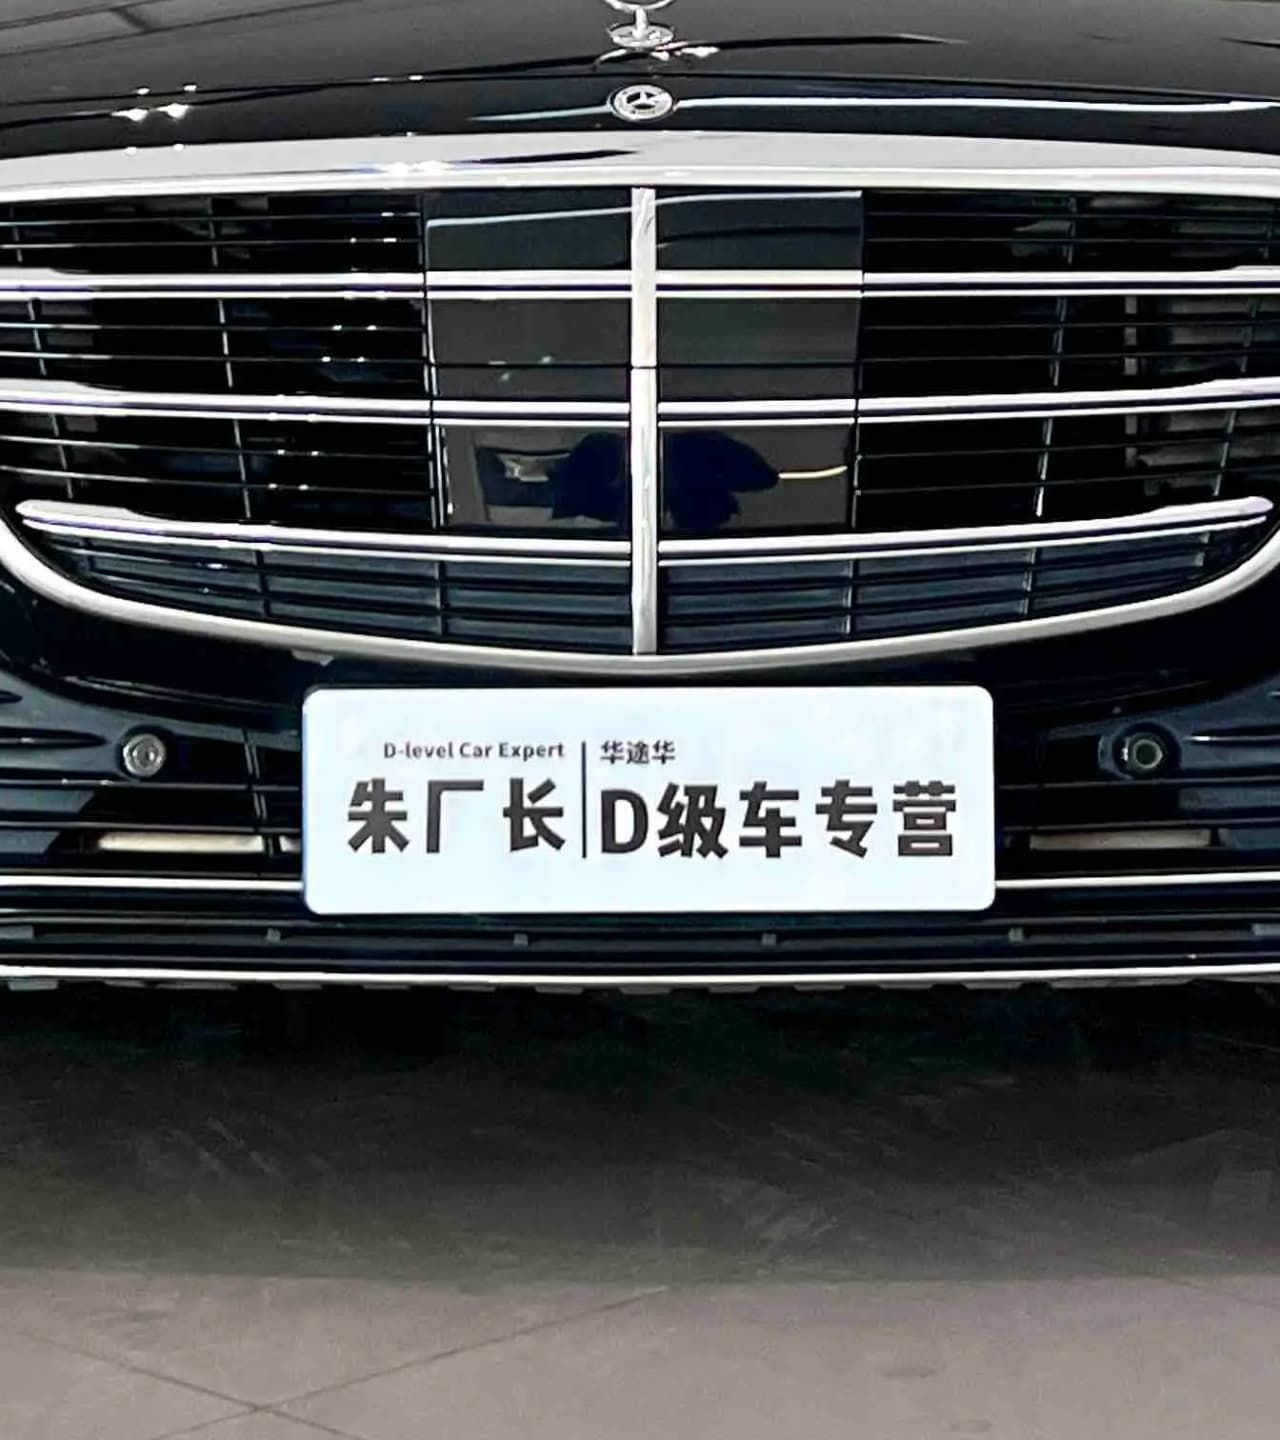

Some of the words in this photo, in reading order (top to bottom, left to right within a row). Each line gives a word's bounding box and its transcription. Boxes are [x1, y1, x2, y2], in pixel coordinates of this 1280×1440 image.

[383, 741, 454, 759] D-level
[459, 741, 493, 759] Car
[498, 741, 565, 762] Expert
[600, 739, 676, 765] 华途华
[347, 777, 566, 854] 朱厂长
[600, 780, 957, 859] D级车专营
